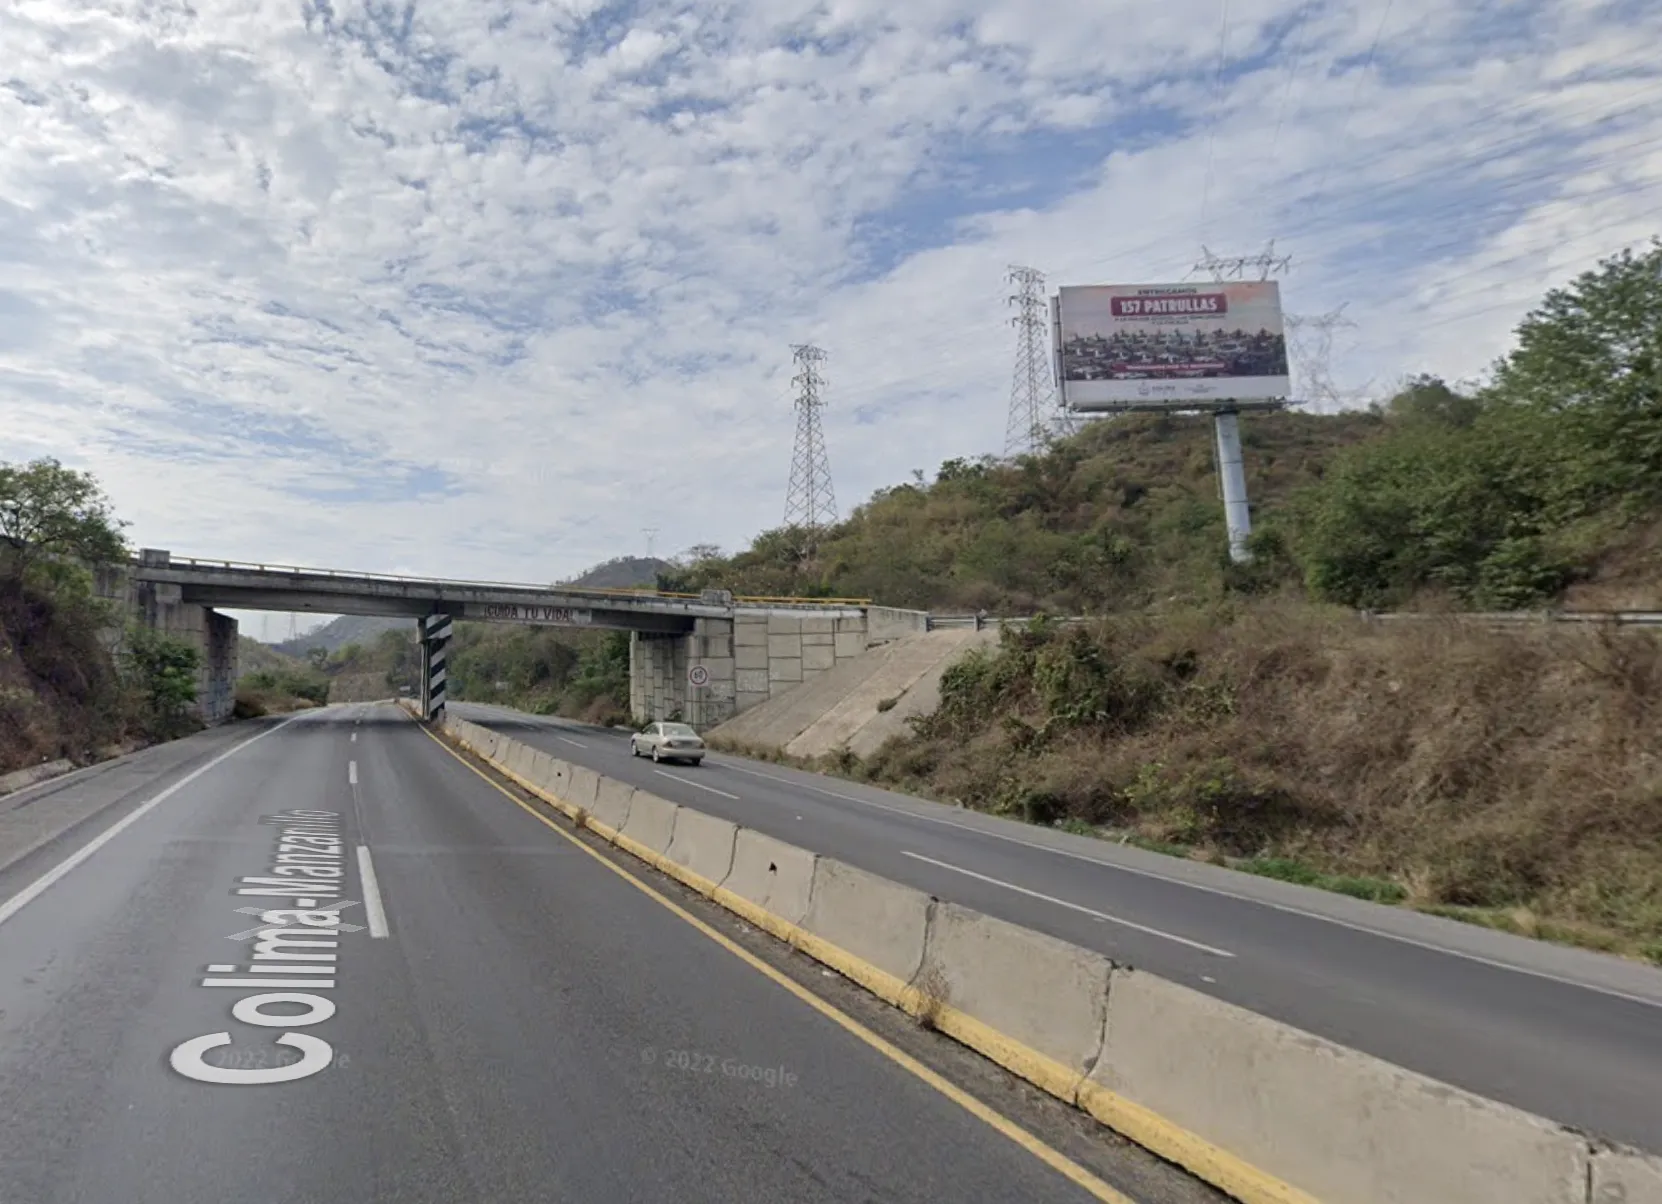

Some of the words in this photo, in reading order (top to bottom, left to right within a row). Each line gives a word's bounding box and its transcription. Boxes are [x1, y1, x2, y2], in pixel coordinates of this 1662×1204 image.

[1121, 300, 1141, 314] 157
[1144, 298, 1218, 314] PATRULLAS
[525, 606, 539, 620] TU
